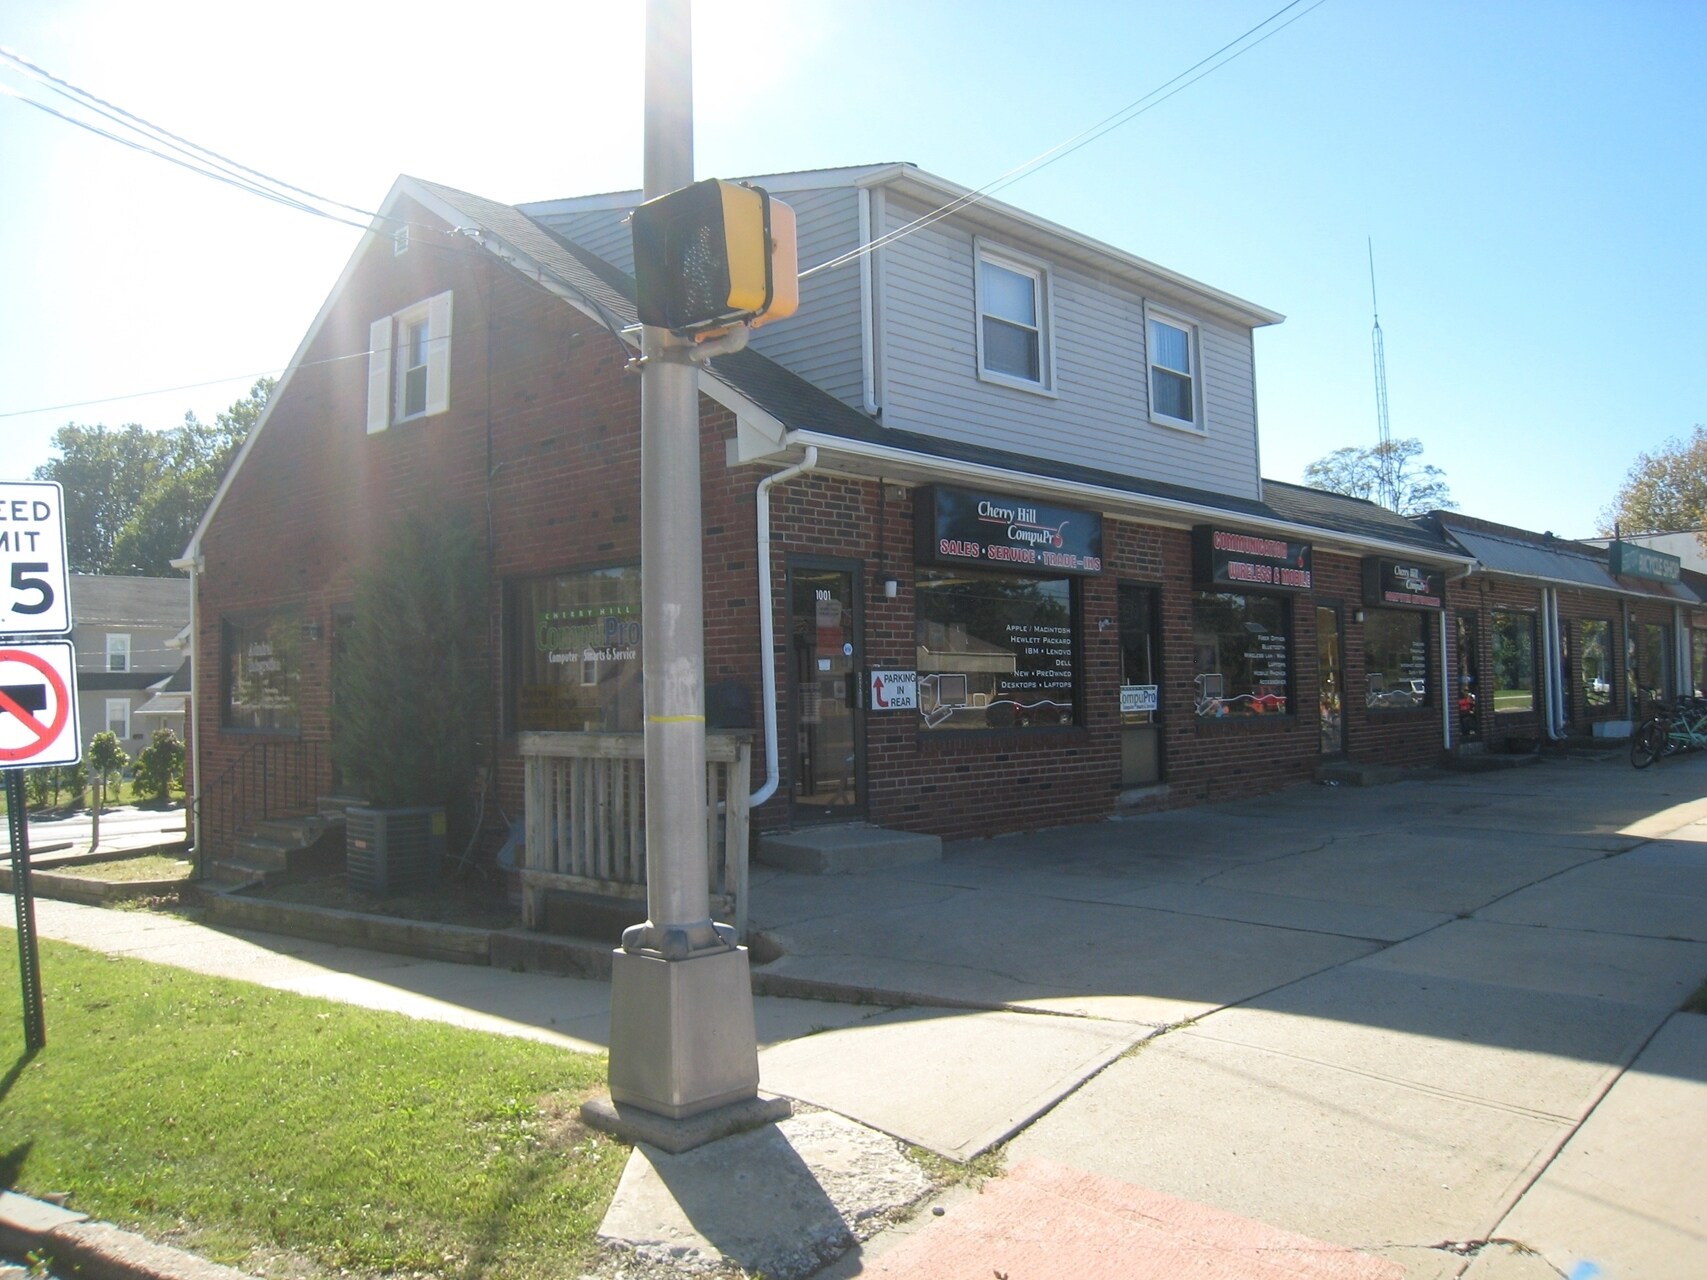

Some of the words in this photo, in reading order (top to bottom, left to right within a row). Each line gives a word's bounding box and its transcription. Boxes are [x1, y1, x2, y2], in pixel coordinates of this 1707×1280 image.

[978, 501, 1015, 523] Cherry
[1017, 508, 1036, 523] Hill
[940, 539, 980, 558] SALES
[988, 545, 1036, 563] SERVICE
[1228, 561, 1272, 584] WIRELESS
[815, 589, 831, 601] 1001
[545, 609, 593, 620] CHERRY
[599, 606, 630, 616] HILL
[612, 647, 636, 661] Service
[884, 674, 916, 683] PARKING
[896, 686, 905, 694] IN
[890, 698, 911, 707] REAR
[1121, 690, 1156, 706] ompuPro
